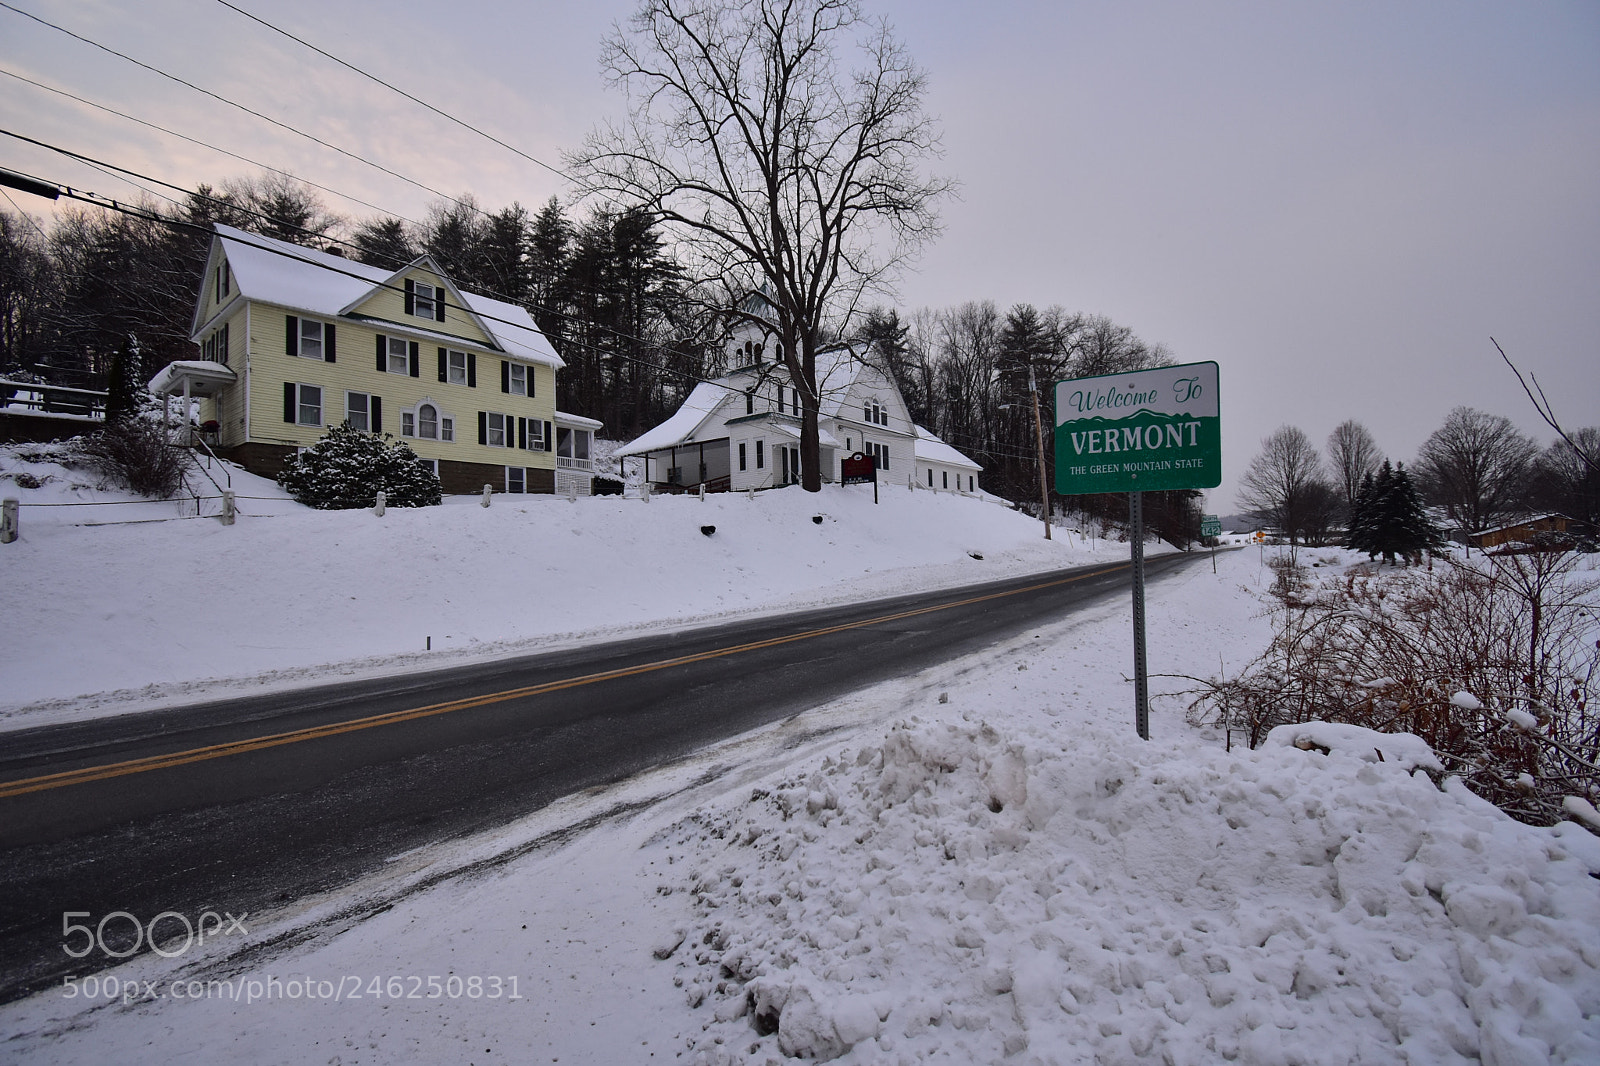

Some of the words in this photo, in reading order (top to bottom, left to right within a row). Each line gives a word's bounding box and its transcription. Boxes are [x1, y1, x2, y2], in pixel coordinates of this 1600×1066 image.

[1069, 387, 1157, 412] Welcome
[1173, 377, 1202, 403] To
[1070, 421, 1201, 455] VERMONT
[1070, 466, 1087, 475] THE
[1090, 464, 1119, 474] GREEN
[1123, 460, 1171, 472] MOUNTAIN
[1174, 458, 1204, 469] STATE
[1204, 527, 1219, 535] 142
